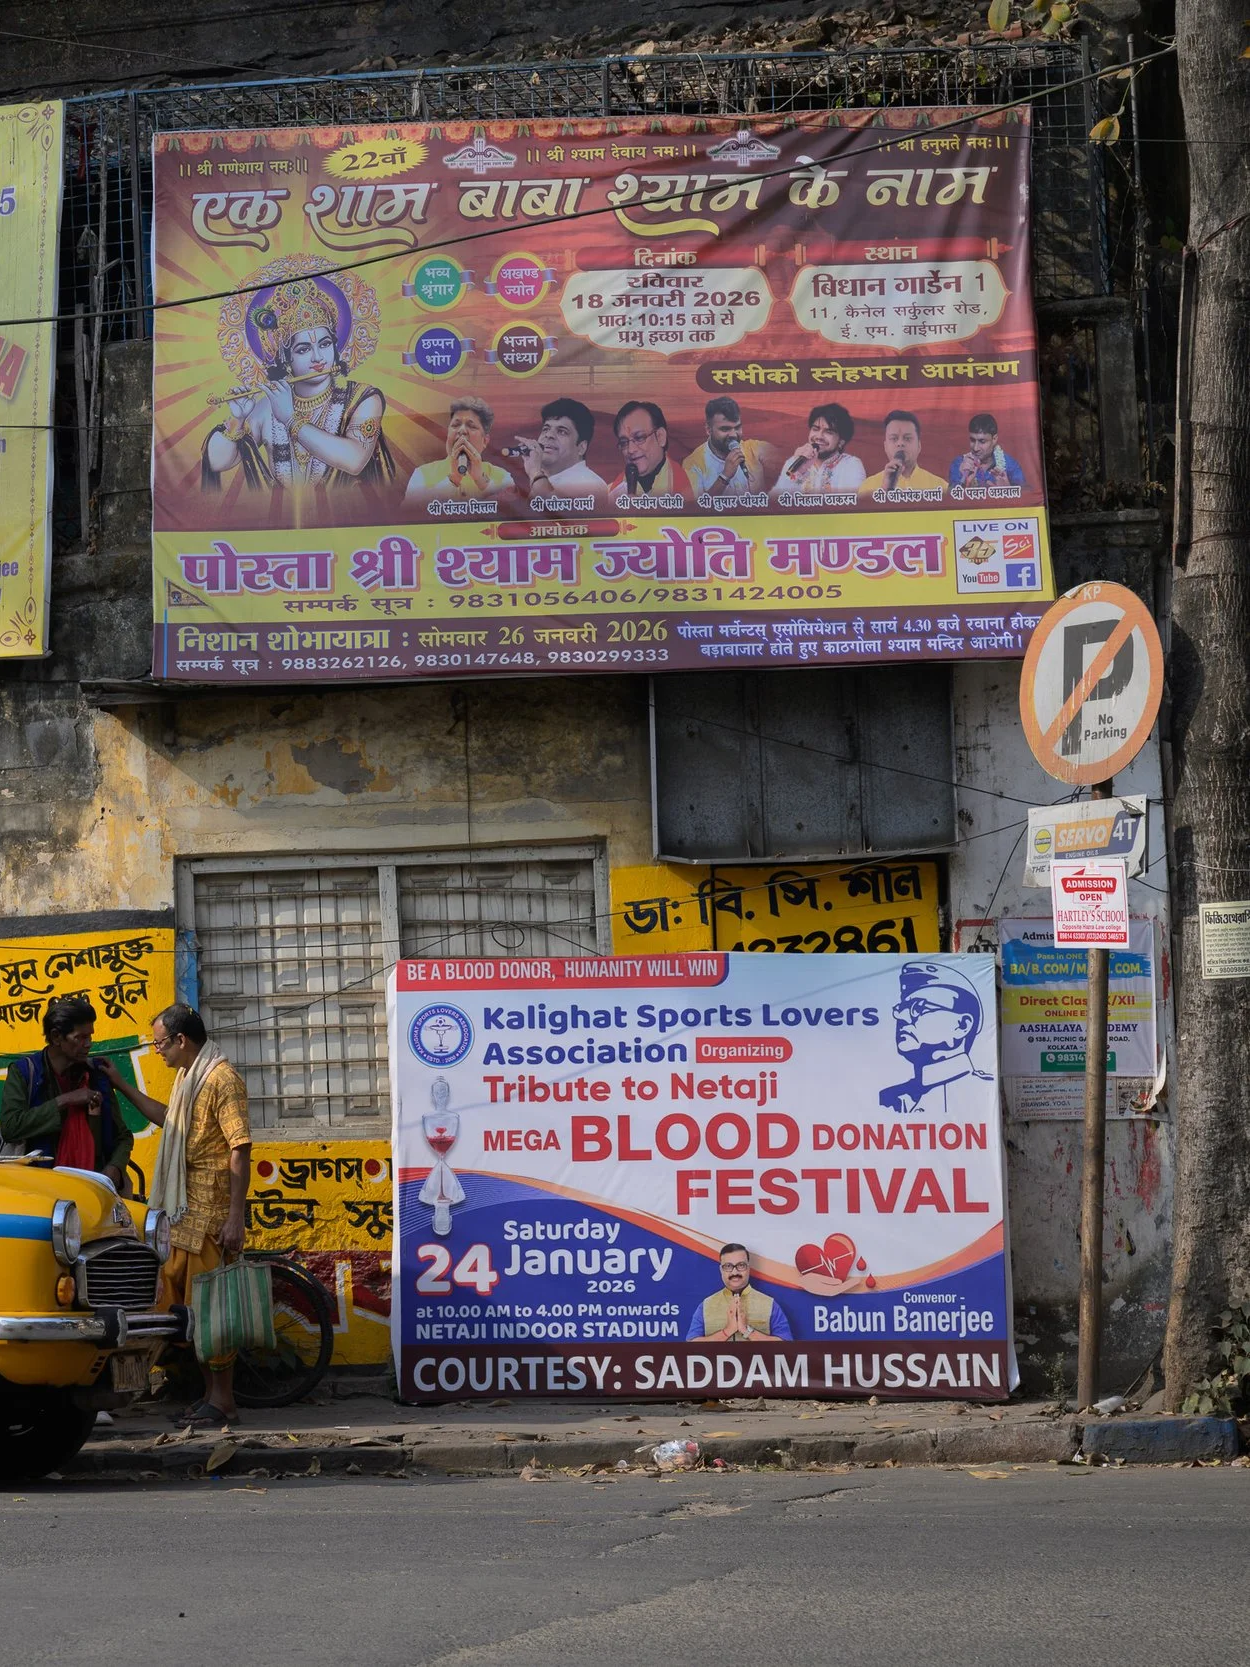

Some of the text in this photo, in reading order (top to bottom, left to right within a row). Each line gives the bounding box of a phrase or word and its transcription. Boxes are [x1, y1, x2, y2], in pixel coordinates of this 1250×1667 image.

[192, 156, 997, 252] एक शाम बाबा श्याम के नाम
[634, 248, 697, 266] दिनांक
[865, 244, 917, 262] स्थान
[425, 266, 450, 281] भव्य
[500, 265, 539, 280] अखण्ड
[504, 281, 535, 297] ज्योत
[627, 274, 705, 290] रविवार
[812, 271, 886, 297] बिधान
[893, 270, 962, 294] गार्डेन
[571, 288, 760, 309] 18 जनवरी 2026
[421, 337, 454, 351] छप्पन
[504, 334, 538, 348] भजन
[426, 351, 451, 367] भोग
[503, 348, 538, 365] संध्या
[711, 356, 1020, 386] सभीको स्नेहभरा आमंत्रण
[529, 524, 589, 537] आयोजक
[963, 522, 1029, 533] LIVE ON
[178, 540, 333, 595] पोस्ता
[351, 536, 419, 590] श्री
[437, 542, 579, 587] श्याम
[592, 526, 752, 579] ज्योति
[766, 534, 944, 576] मण्डल
[1083, 586, 1101, 600] KP
[283, 594, 359, 612] सम्पर्क
[371, 597, 412, 616] सूत्र
[1098, 713, 1114, 726] No
[1084, 727, 1127, 741] Parking
[1057, 818, 1136, 848] SERVO 4T
[840, 865, 922, 903] শীল
[1066, 880, 1113, 888] ADMISSION
[1080, 893, 1102, 901] OPEN
[1058, 910, 1125, 922] HARTLEY'S SCHOOL
[45, 936, 154, 978] নেশামুক্ত
[407, 959, 718, 983] BE A BLOOD DONOR, HUMANITY WILL WIN
[99, 972, 148, 1024] তুলি
[1020, 995, 1087, 1006] Direct Clas
[483, 1004, 879, 1036] Kalighat Sports Lovers
[1019, 1024, 1082, 1032] AASHALAYA
[483, 1040, 785, 1066] Association Organizing
[483, 1071, 778, 1107] Tribute to Netaji
[483, 1112, 987, 1163] MEGA BLOOD DONATION
[677, 1167, 989, 1215] FESTIVAL
[504, 1220, 620, 1247] Saturday
[417, 1244, 500, 1295] 24
[505, 1245, 673, 1282] January
[587, 1280, 636, 1294] 2026
[903, 1292, 956, 1305] Convenor
[416, 1302, 680, 1319] at 10.00 AM to 4.00 PM onwards
[814, 1304, 994, 1336] Babun Banerjee
[416, 1321, 679, 1340] NETAJI INDOOR STADIUM
[413, 1353, 1001, 1392] COURTESY: SADDAM HUSSAIN
